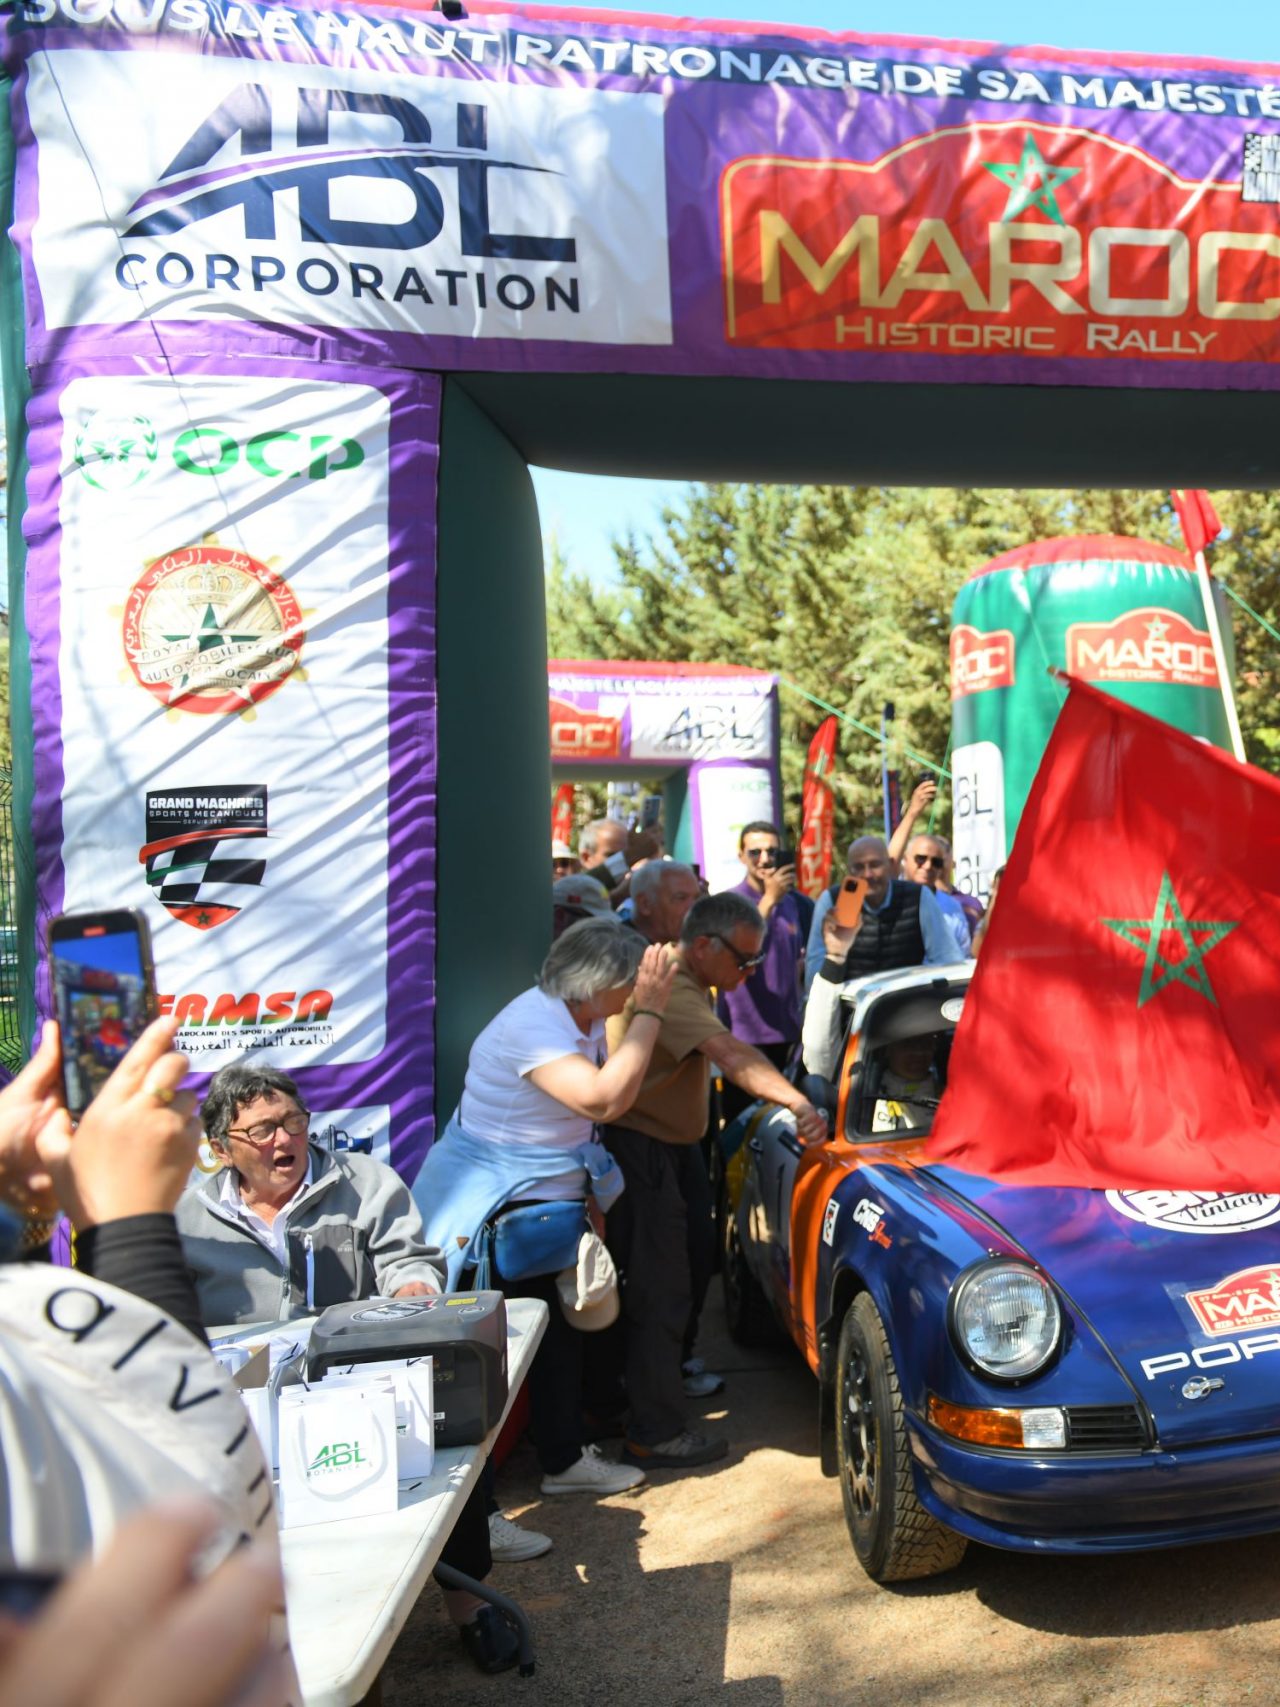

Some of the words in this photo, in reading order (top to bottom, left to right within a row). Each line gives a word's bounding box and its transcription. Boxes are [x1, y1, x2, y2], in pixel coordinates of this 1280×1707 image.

[224, 7, 298, 42] LE
[315, 15, 500, 64] HAUT
[515, 33, 879, 90] PATRONAGE
[892, 63, 965, 97] DE
[976, 69, 1052, 103] SA
[119, 82, 577, 262] ABL
[115, 251, 580, 314] CORPORATION
[835, 314, 1056, 352] HISTORIC
[1086, 322, 1220, 355] RALLY
[172, 427, 365, 480] OCP
[953, 646, 1006, 683] ROC
[149, 797, 194, 809] GRAND
[196, 796, 264, 809] MAGHREB
[149, 810, 190, 818] SPORTS
[956, 773, 993, 818] BL
[955, 854, 991, 897] BL
[240, 1028, 273, 1036] SPORTS
[306, 1461, 374, 1478] BOTANICAS
[308, 1440, 367, 1471] ABL
